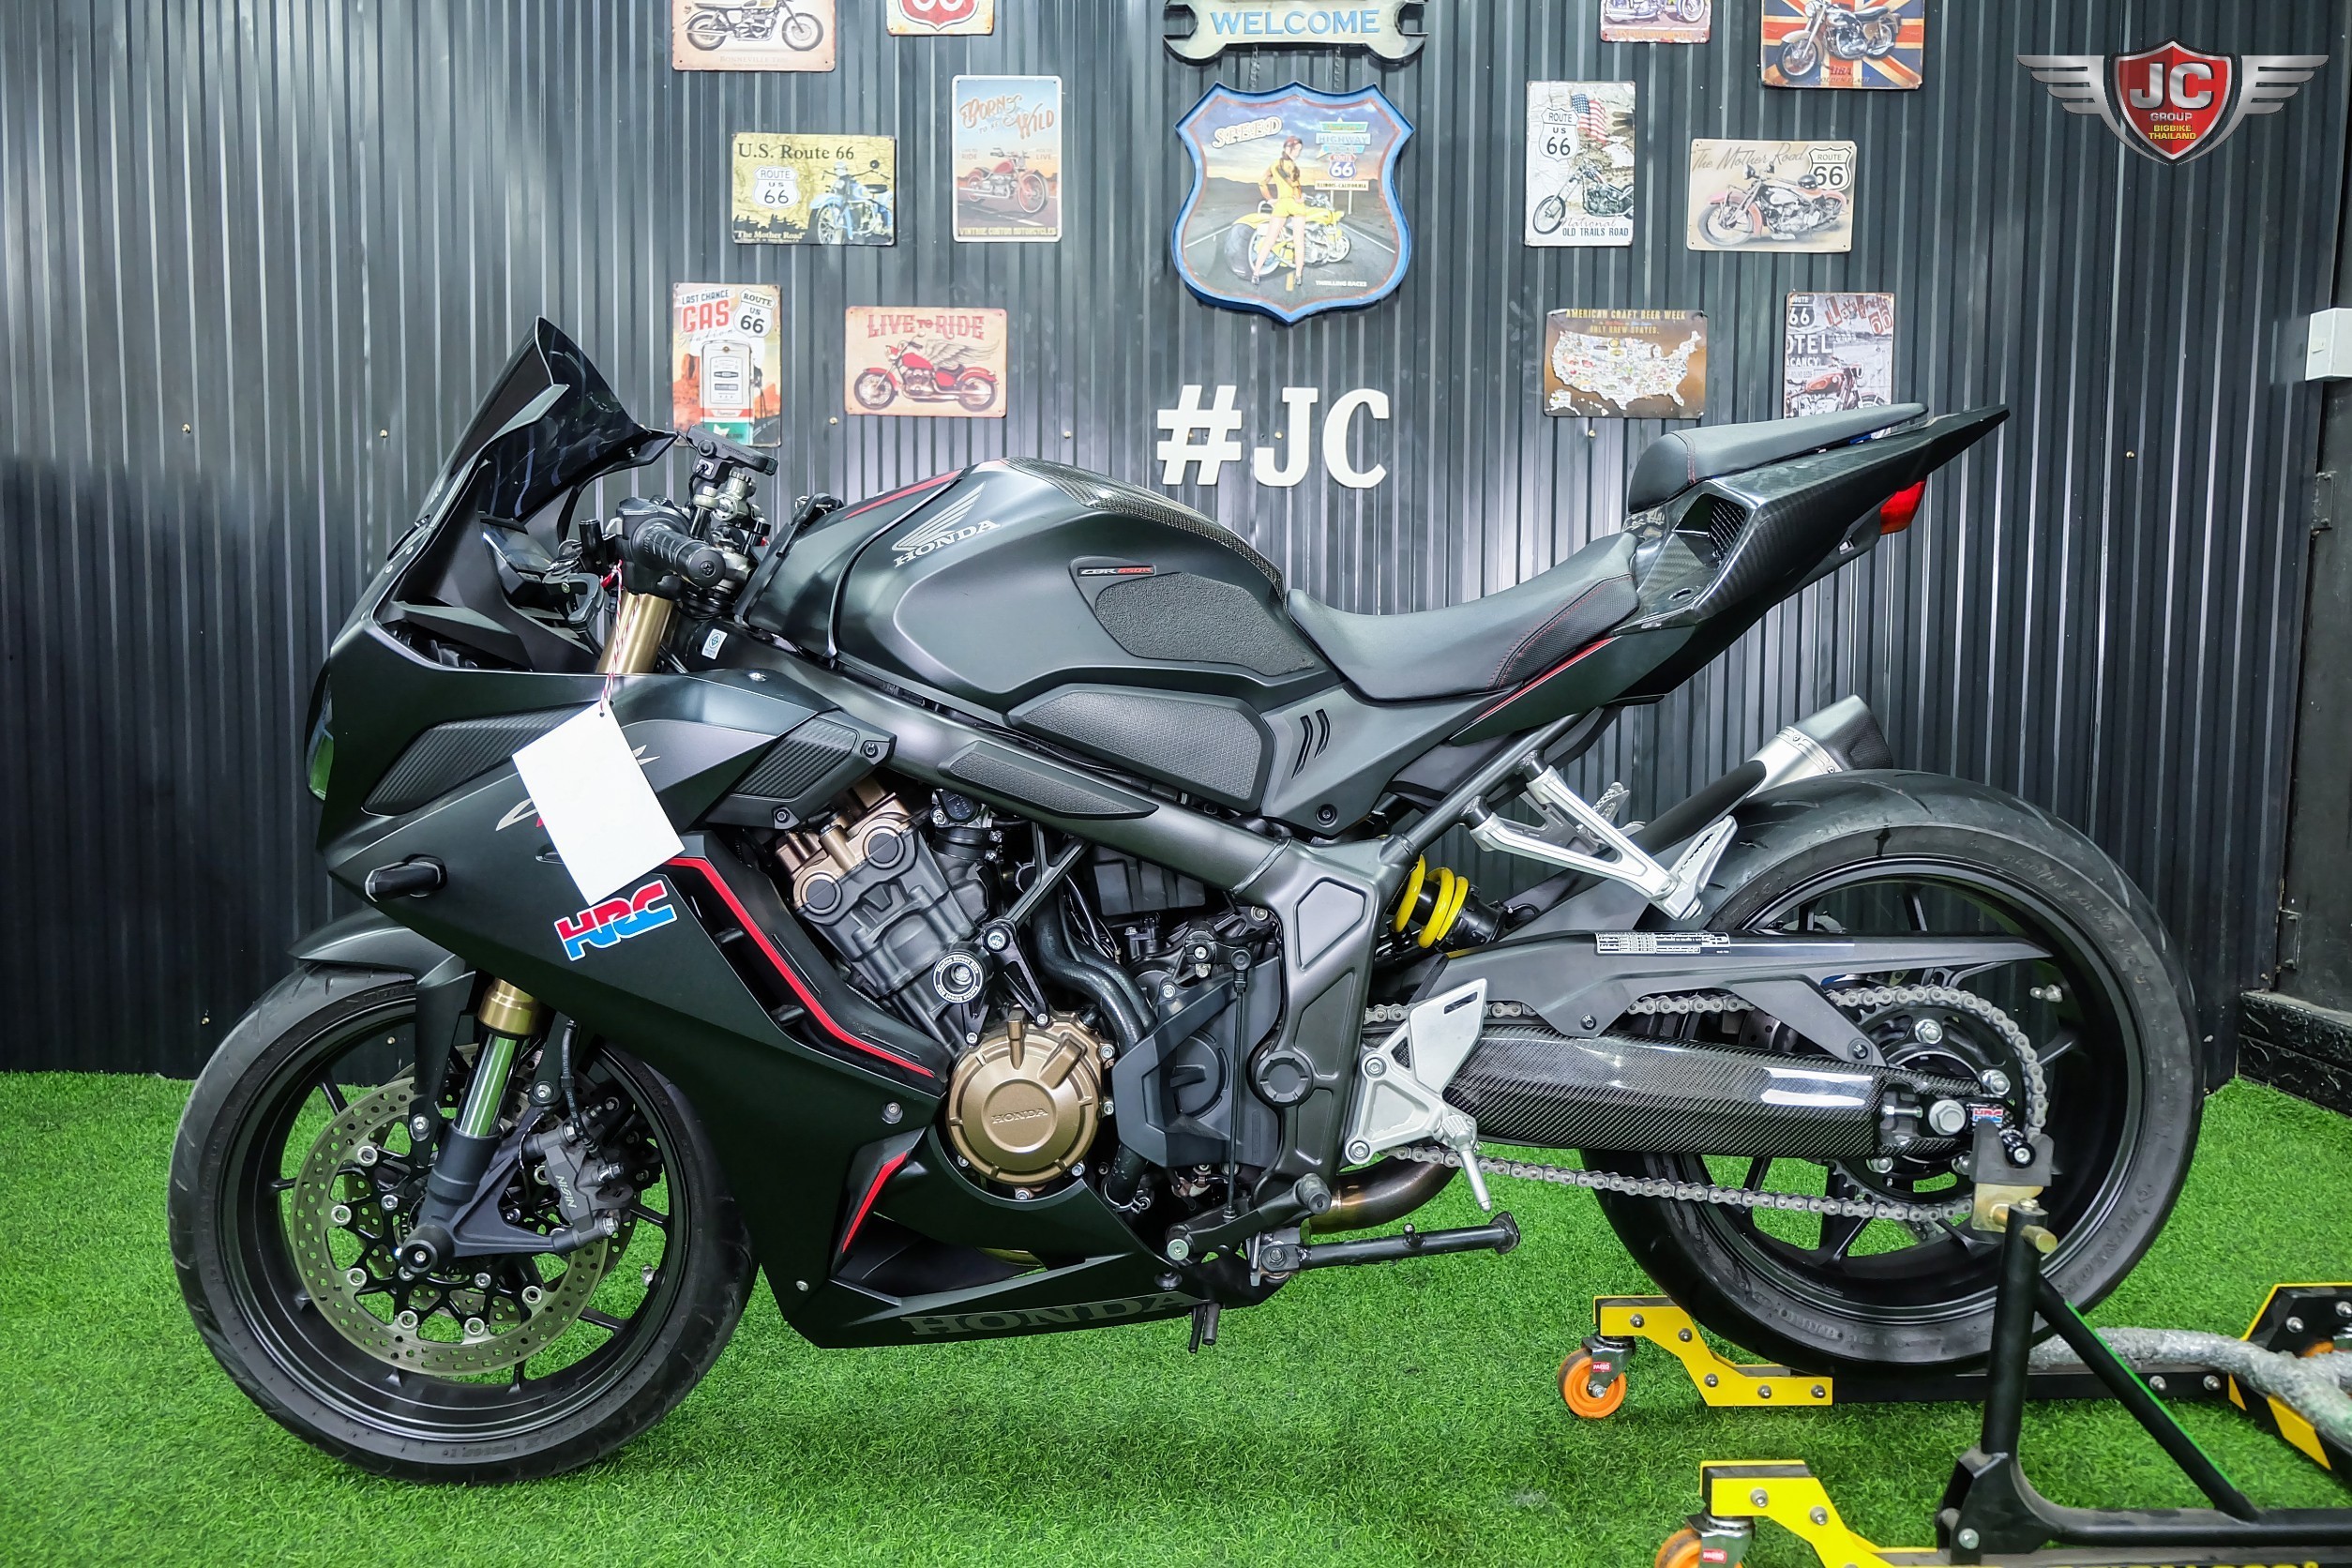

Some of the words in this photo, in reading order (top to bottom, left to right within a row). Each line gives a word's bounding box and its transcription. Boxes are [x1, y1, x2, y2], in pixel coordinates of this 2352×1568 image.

[1211, 8, 1380, 35] WELCOME
[1003, 102, 1056, 140] WILD
[1548, 113, 1573, 123] ROUTE
[1212, 116, 1283, 149] SPEED
[1319, 135, 1368, 145] HIGHWAY
[738, 143, 775, 158] U.S.
[779, 144, 830, 159] Route
[836, 146, 854, 160] 66
[1546, 136, 1571, 156] 66
[1692, 148, 1713, 172] The
[1717, 145, 1768, 171] Mother
[1773, 142, 1810, 165] Road
[761, 170, 791, 178] ROUTE
[1331, 161, 1354, 177] 66
[1814, 165, 1844, 187] 66
[764, 189, 789, 204] 66
[753, 231, 781, 240] Mother
[1562, 228, 1576, 236] OLD
[1580, 228, 1606, 236] TRAILS
[1608, 228, 1629, 236] ROAD
[682, 295, 699, 305] LAST
[701, 289, 729, 302] CHANCE
[743, 293, 773, 307] ROUTE
[683, 299, 730, 333] GAS
[750, 307, 761, 316] US
[1565, 309, 1607, 319] AMERICAN
[1610, 309, 1637, 320] CRAFT
[1640, 309, 1661, 320] BEER
[1664, 310, 1686, 320] WEEK
[1789, 307, 1811, 325] 66
[740, 314, 765, 334] 66
[867, 314, 916, 339] LIVE
[916, 319, 934, 329] TO
[935, 315, 985, 340] RIDE
[893, 518, 1002, 568] HONDA
[554, 880, 677, 961] HRC
[990, 1107, 1048, 1124] HONDA
[898, 1291, 1186, 1335] HONDA
